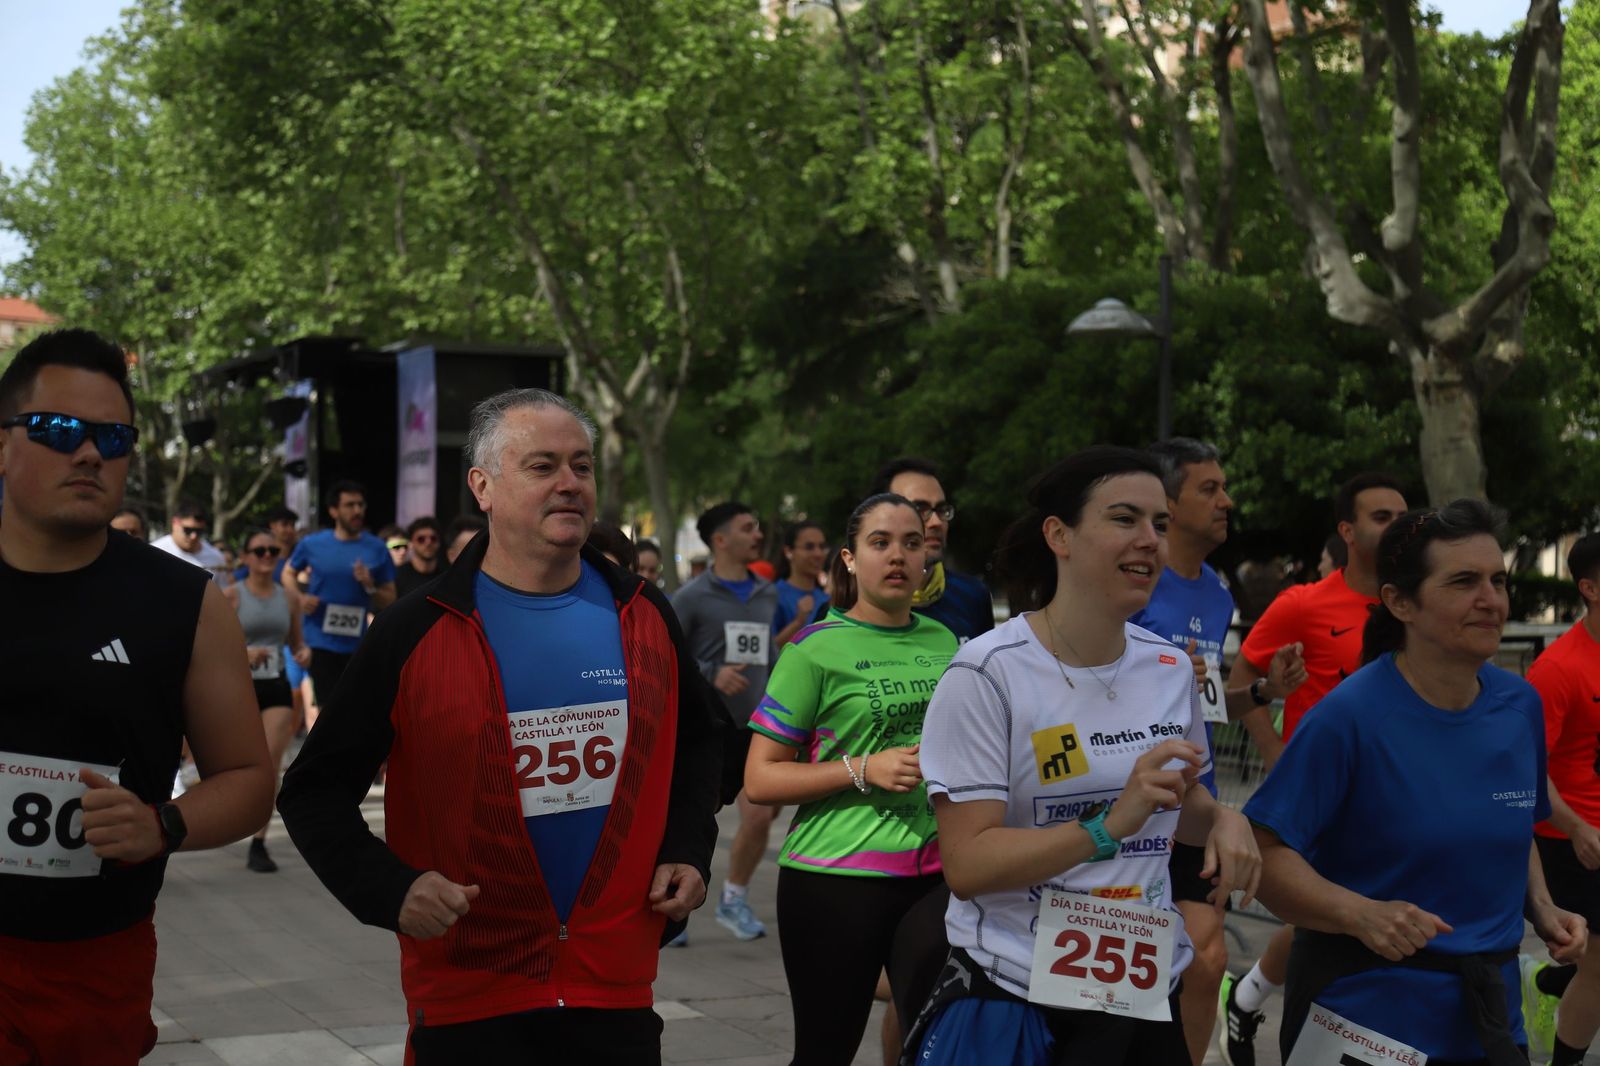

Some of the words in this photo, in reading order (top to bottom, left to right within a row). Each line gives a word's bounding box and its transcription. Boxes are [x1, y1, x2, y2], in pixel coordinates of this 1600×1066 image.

[329, 613, 360, 628] 220
[738, 634, 760, 654] 98
[581, 669, 625, 678] CASTILLA
[880, 678, 906, 695] En
[519, 718, 533, 727] DE
[537, 716, 550, 725] LA
[552, 708, 620, 724] COMUNIDAD
[515, 727, 564, 741] CASTILLA
[567, 726, 574, 734] Y
[576, 722, 604, 733] LEÓN
[1090, 729, 1146, 746] Martín
[1149, 721, 1184, 737] Peña
[512, 736, 616, 789] 256
[9, 765, 64, 781] CASTILLA
[68, 773, 75, 781] Y
[1492, 791, 1526, 799] CASTILLA
[8, 792, 87, 850] 80
[1120, 837, 1168, 854] VALDÉS
[1100, 888, 1132, 899] DHL
[1051, 896, 1071, 910] DÍA
[1074, 902, 1090, 913] DE
[1093, 904, 1106, 915] LA
[1108, 908, 1169, 928] COMUNIDAD
[1067, 914, 1117, 931] CASTILLA
[1120, 923, 1126, 931] Y
[1128, 923, 1153, 938] LEÓN
[1049, 929, 1158, 990] 255
[1313, 1014, 1327, 1028] DÍA
[1327, 1022, 1341, 1035] DE
[1341, 1031, 1386, 1055] CASTILLA
[1388, 1049, 1396, 1057] Y
[1396, 1052, 1419, 1066] LEÓN
